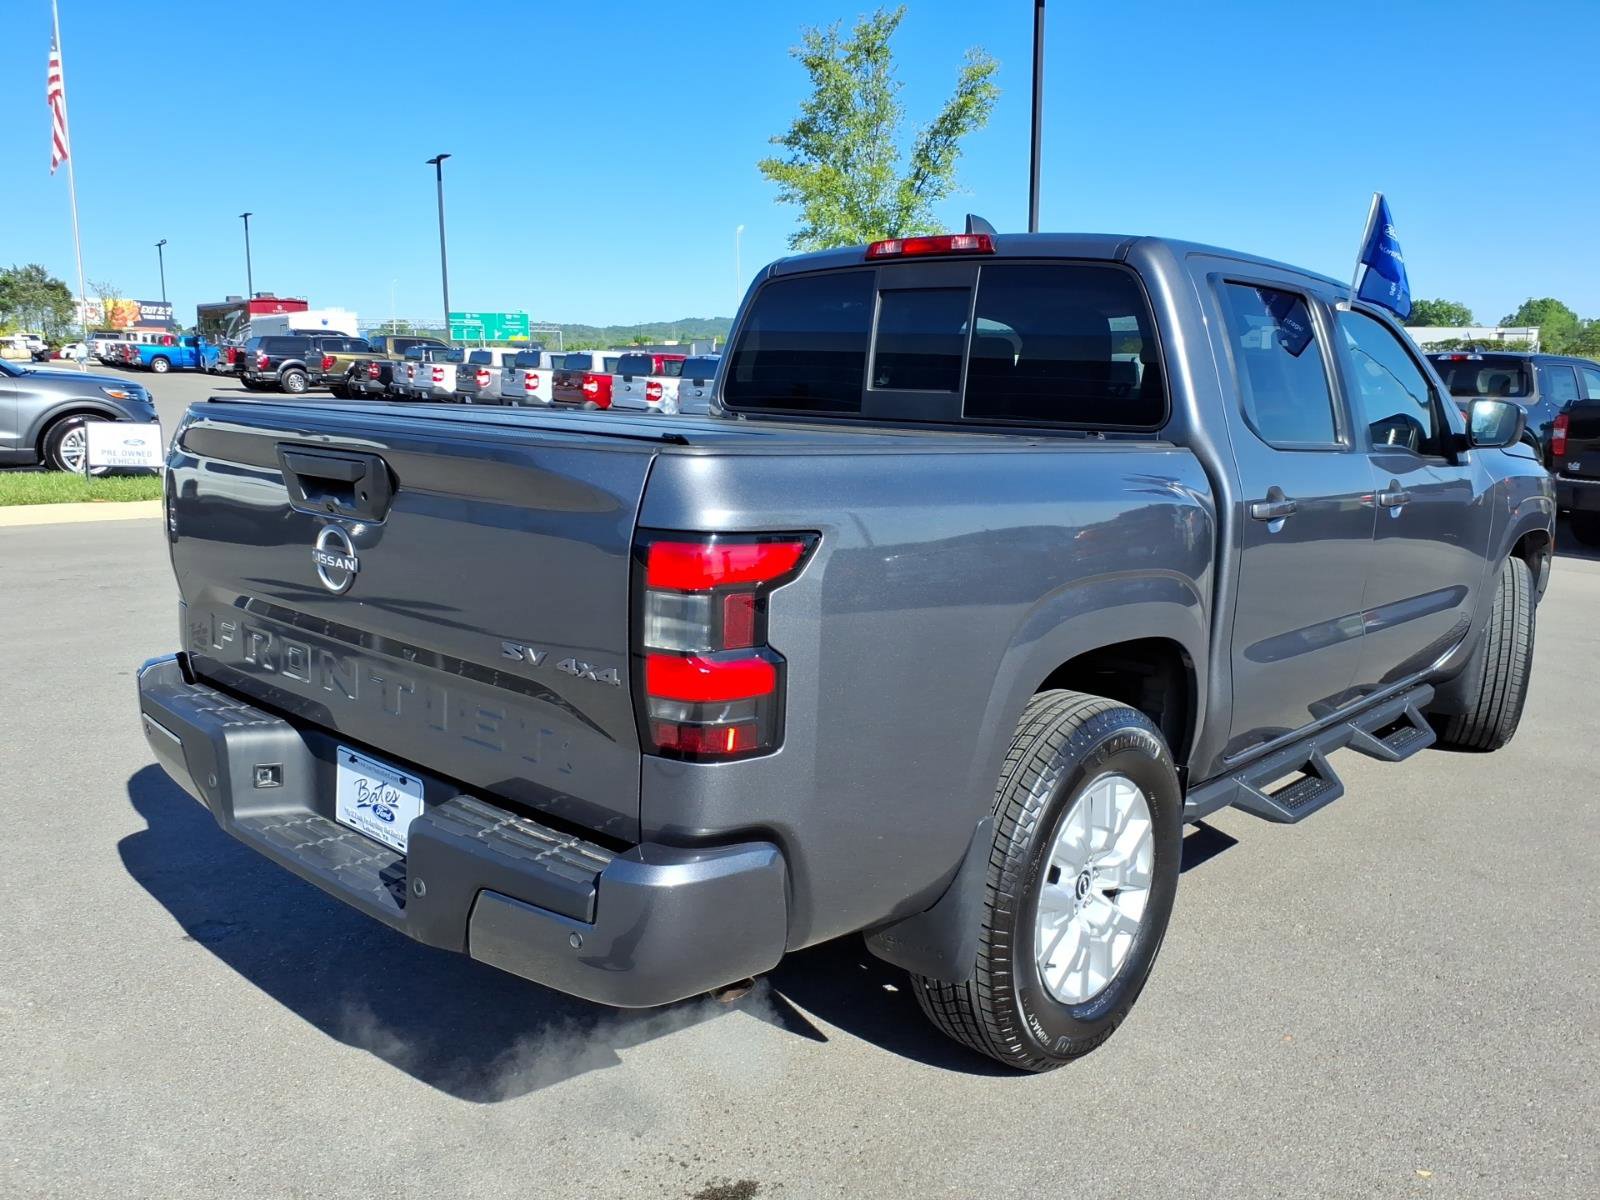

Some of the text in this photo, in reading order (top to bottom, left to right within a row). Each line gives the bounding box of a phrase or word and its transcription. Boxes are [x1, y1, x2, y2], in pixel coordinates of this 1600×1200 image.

[141, 306, 158, 314] EXIT
[107, 457, 147, 465] VEHICLES
[121, 449, 152, 457] OWNED
[312, 551, 355, 571] NISSAN
[502, 641, 547, 665] SV
[210, 611, 577, 774] FRONTIER
[354, 779, 400, 803] Bates
[1028, 1013, 1051, 1046] PRIMACY
